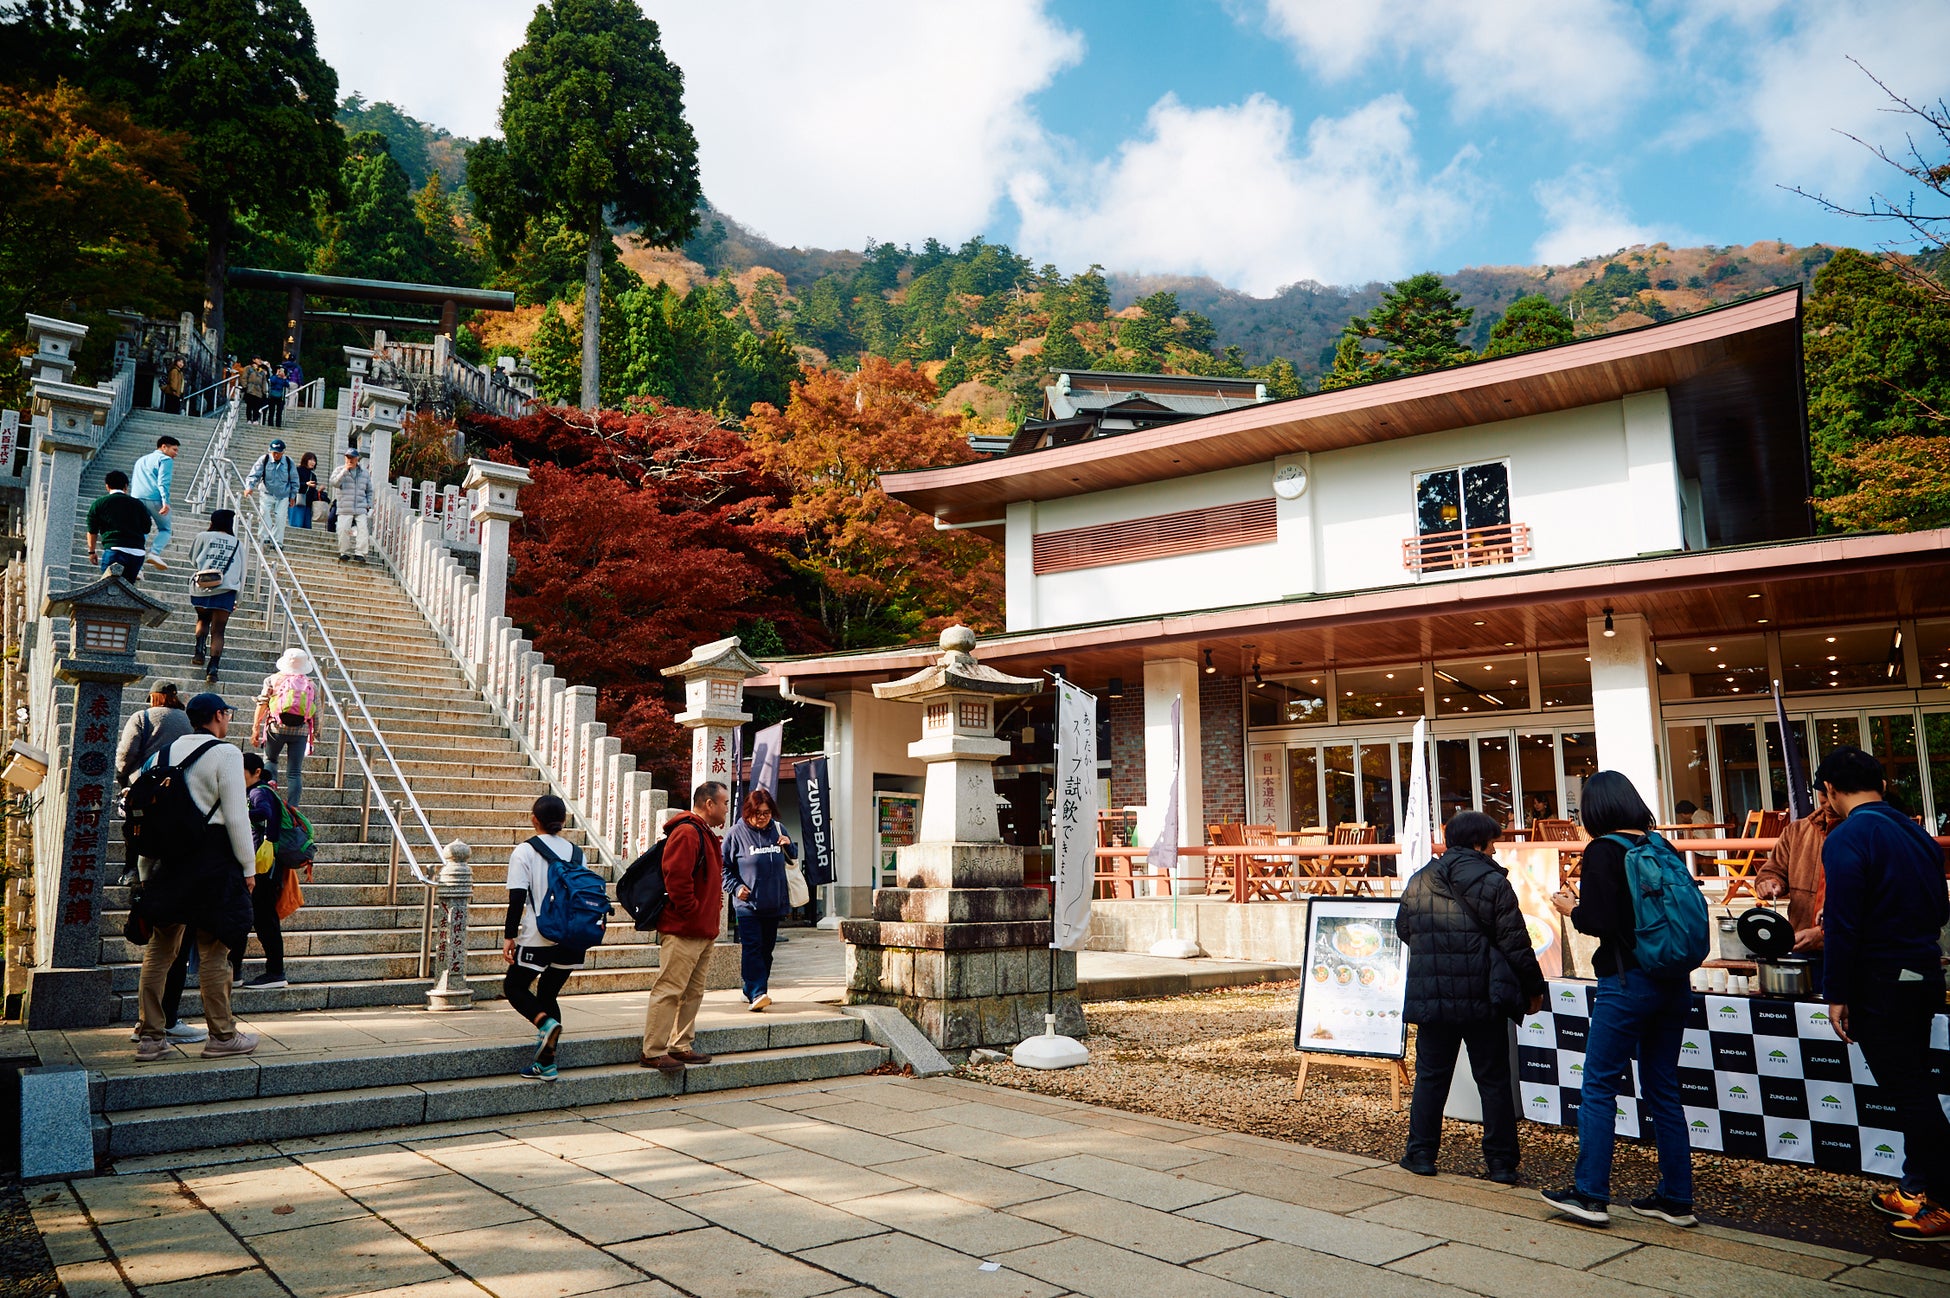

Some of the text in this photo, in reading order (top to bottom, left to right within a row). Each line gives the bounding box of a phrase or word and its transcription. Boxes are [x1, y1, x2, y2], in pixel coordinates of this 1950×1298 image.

[85, 694, 111, 744] 奉献
[712, 735, 727, 774] 奉献
[1262, 753, 1276, 823] 祝 日本遺産「大
[807, 778, 829, 868] ZUND-BAR
[438, 917, 448, 962] 左側通行
[451, 910, 464, 973] おはらい石
[1562, 1029, 1584, 1037] ZUND-BAR
[1719, 1048, 1747, 1056] ZUND-BAR
[1527, 1061, 1551, 1069] ZUND-BAR
[1682, 1083, 1708, 1091] ZUND-BAR
[1769, 1093, 1798, 1102] ZUND-BAR
[1821, 1102, 1842, 1110] AFURI
[1865, 1103, 1896, 1112] ZUND-BAR
[1729, 1128, 1757, 1137] ZUND-BAR
[1821, 1140, 1851, 1149] ZUND-BAR
[1874, 1152, 1895, 1160] AFURI
